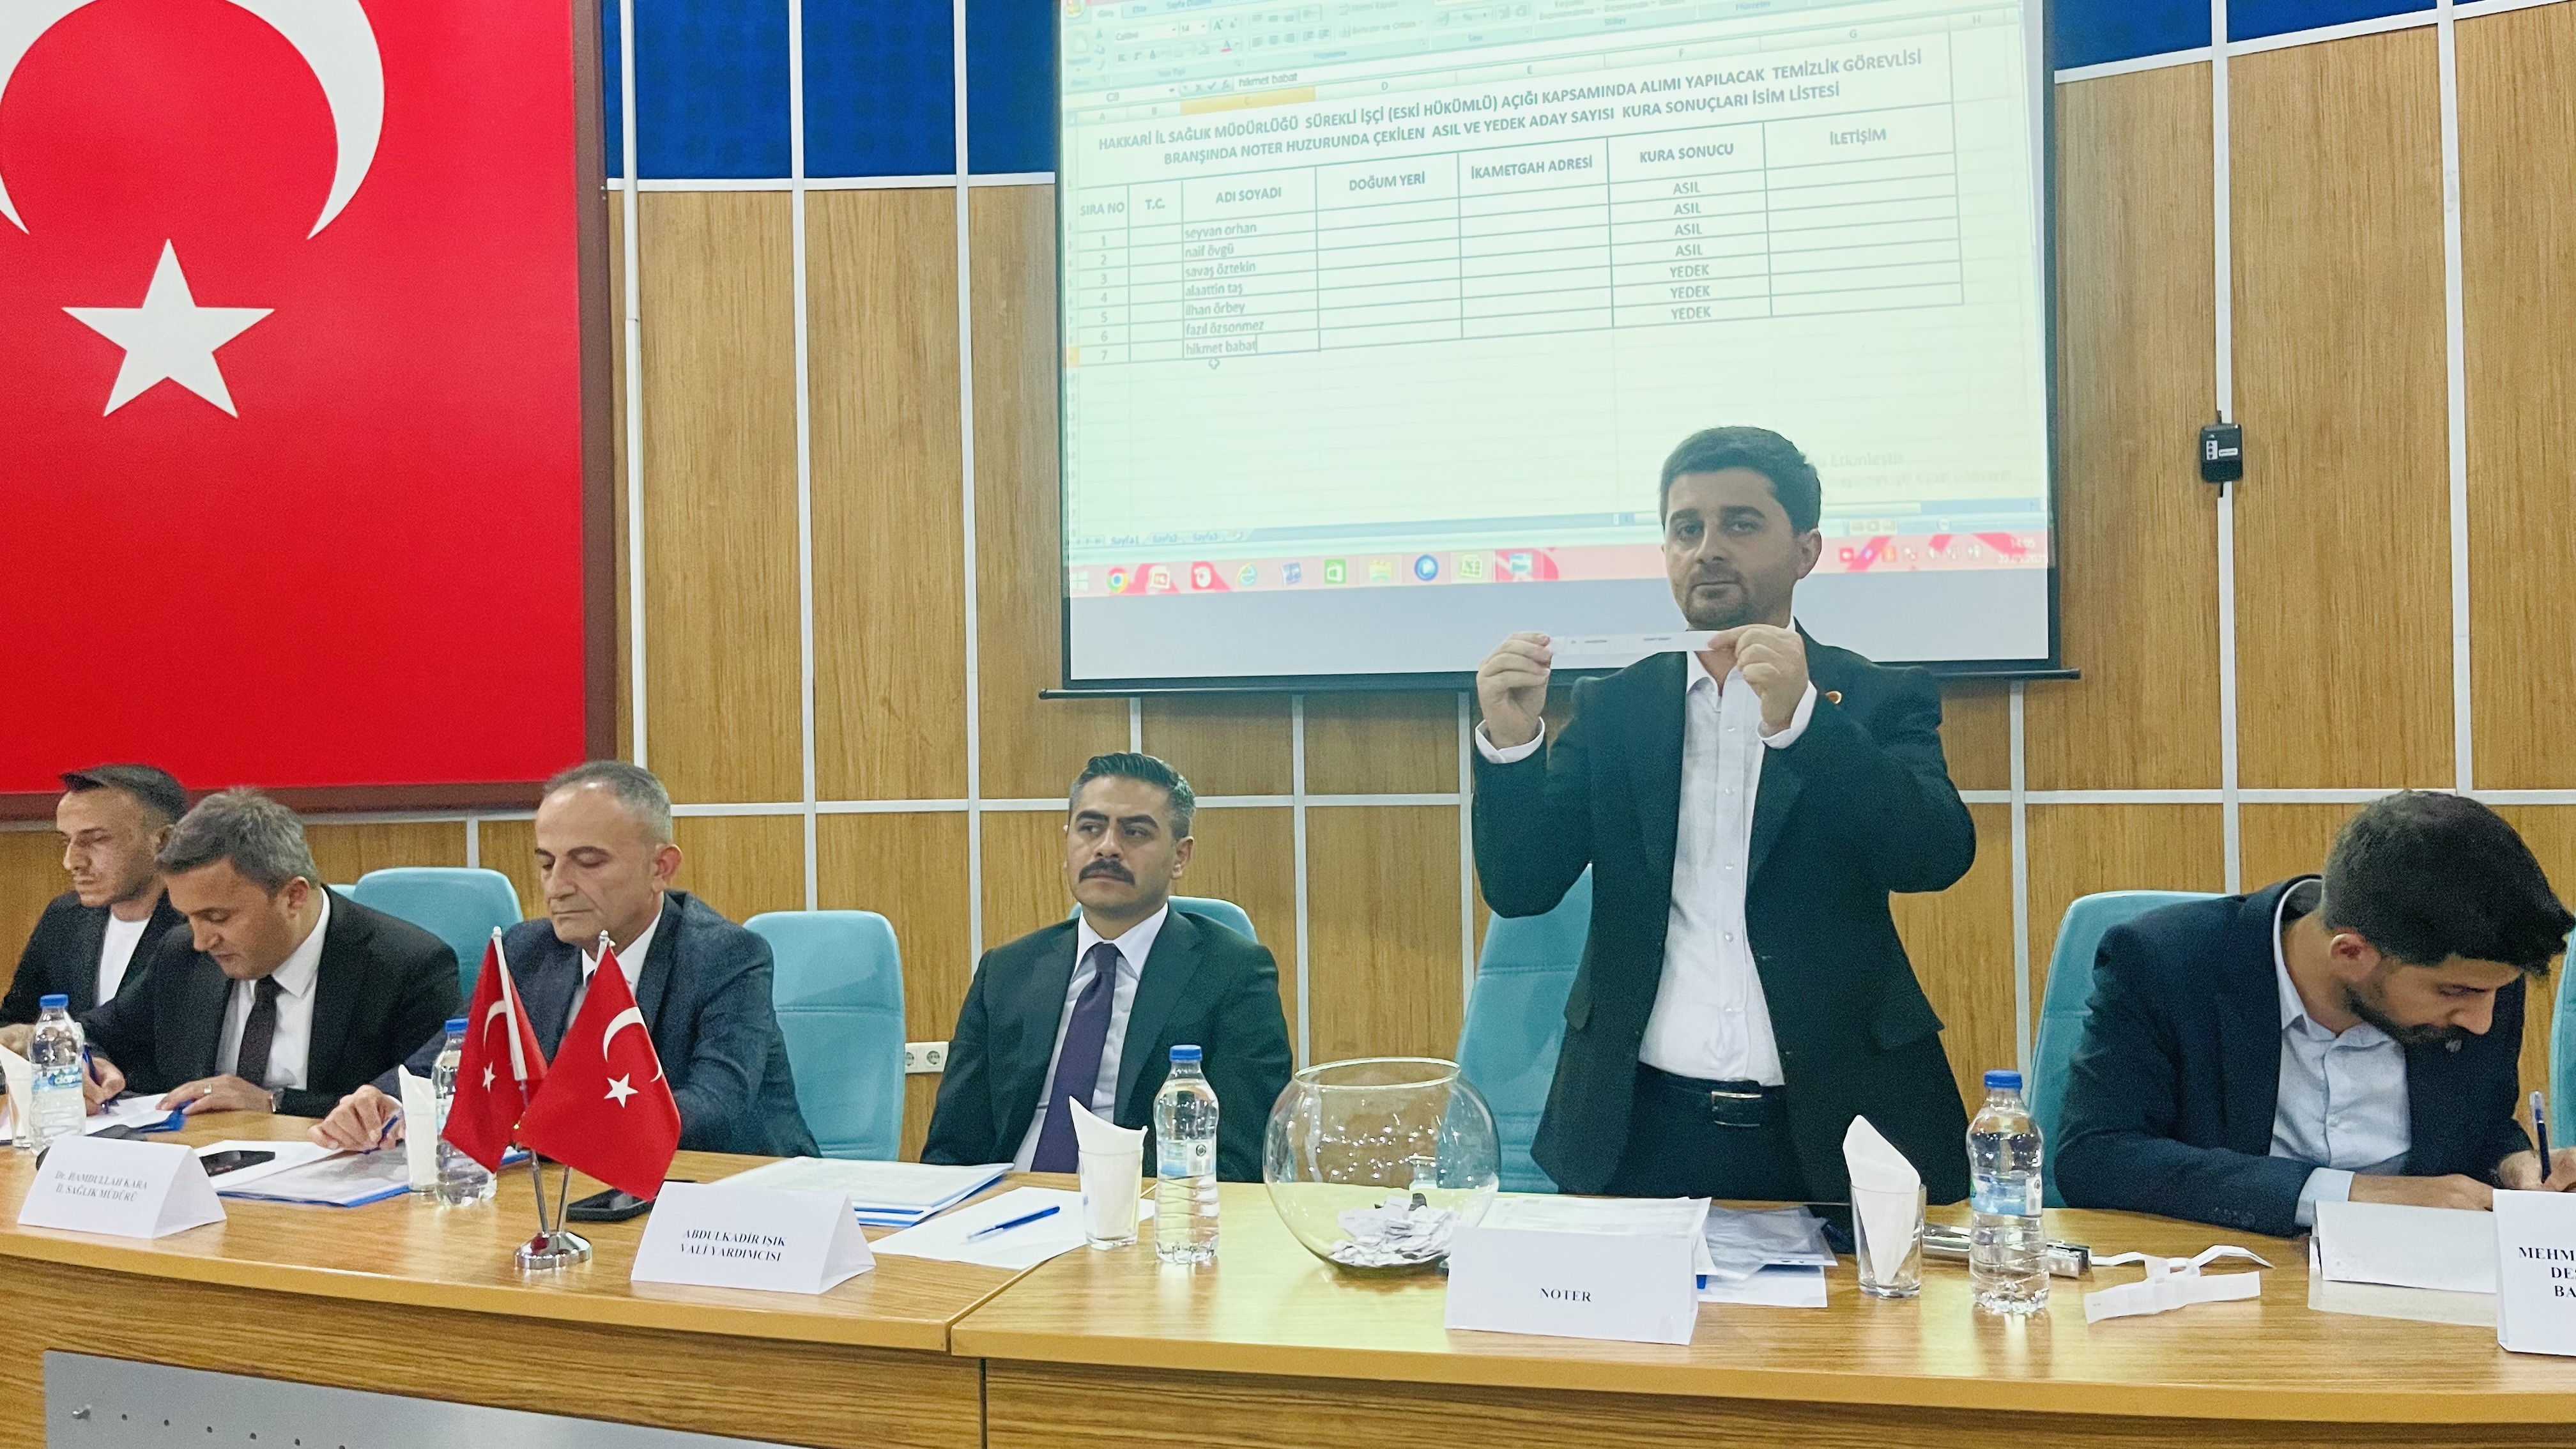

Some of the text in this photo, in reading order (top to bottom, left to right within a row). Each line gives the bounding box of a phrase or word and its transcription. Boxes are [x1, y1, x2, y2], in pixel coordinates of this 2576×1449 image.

[1239, 73, 1298, 87] hikmet babat
[1099, 48, 1922, 150] HAKKARİ İL SAĞLIK MÜDÜRLÜĞÜ SÜREKLİ İŞÇİ (ESKİ HÜKÜMLÜ) AÇIĞI KAPSAMINDA ALIMI YAPILACAK TEMİZLİK GÖREVLİSİ
[1165, 81, 1839, 165] BRANŞINDA NOTER HUZURUNDA ÇEKİLEN ASIL VE YEDEK ADAY SAYISI KURA SONUÇLARI İSİM LİSTESİ
[1830, 128, 1886, 146] İLETİŞİM
[1639, 143, 1734, 164] KURA SONUCU
[1471, 155, 1592, 180] İKAMETGAH ADRESİ
[1349, 171, 1425, 191] DOĞUM YERİ
[1673, 181, 1700, 194] ASIL
[1216, 187, 1282, 204] ADI SOYADI
[1080, 201, 1125, 216] SIRA NO
[1146, 199, 1165, 210] T.C.
[1674, 203, 1701, 215] ASIL
[1184, 224, 1257, 240] seyvan orhan
[1675, 224, 1702, 236] ASIL
[1101, 235, 1106, 247] 1
[1184, 243, 1234, 258] naif övgü
[1675, 244, 1703, 256] ASIL
[1101, 255, 1107, 266] 2
[1185, 261, 1256, 279] savaş öztekin
[1669, 264, 1710, 278] YEDEK
[1101, 273, 1107, 284] 3
[1185, 282, 1243, 296] alaattin taş
[1670, 286, 1710, 299] YEDEK
[1100, 293, 1107, 303] 4
[1185, 301, 1245, 316] ilhan örbey
[1671, 306, 1711, 320] YEDEK
[1101, 312, 1107, 323] 5
[1210, 321, 1264, 334] özsonmez
[1101, 331, 1107, 342] 6
[1186, 340, 1256, 355] hikmet babat
[1101, 350, 1107, 361] 7
[1111, 535, 1140, 546] Sayfa1
[55, 1170, 148, 1190] Dr. HAMDULLAH KARA
[65, 1184, 96, 1197] SAĞLIK
[99, 1188, 137, 1202] MÜDÜRÜ
[683, 1229, 787, 1247] ABDULKADİR IŞIK
[681, 1243, 781, 1261] VALİ YARDIMCISI
[2518, 1246, 2575, 1261] MEHM
[2551, 1267, 2576, 1280] DE
[1540, 1288, 1591, 1302] NOTER
